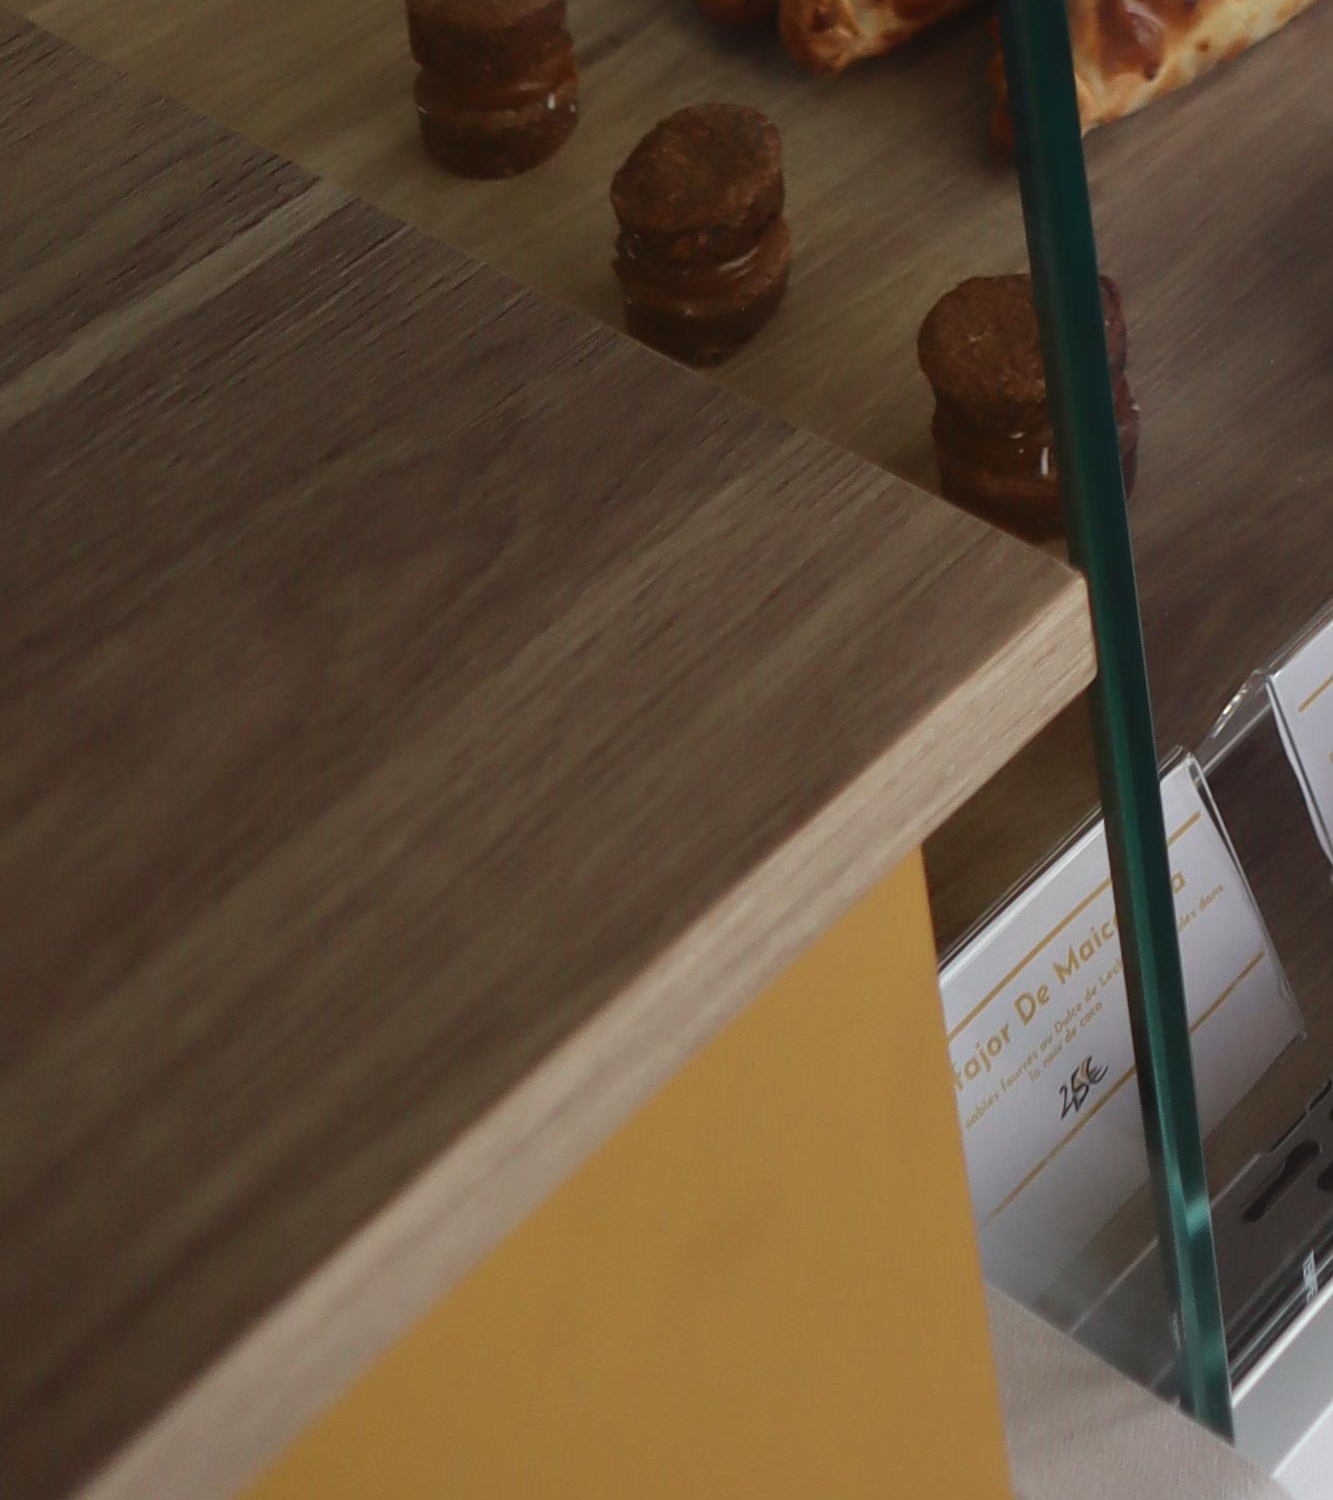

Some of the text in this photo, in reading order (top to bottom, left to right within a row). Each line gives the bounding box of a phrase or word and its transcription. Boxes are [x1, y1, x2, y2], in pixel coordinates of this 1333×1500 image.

[951, 1021, 1011, 1092] fajor
[1013, 983, 1051, 1027] De
[1054, 1000, 1083, 1034] Dulce
